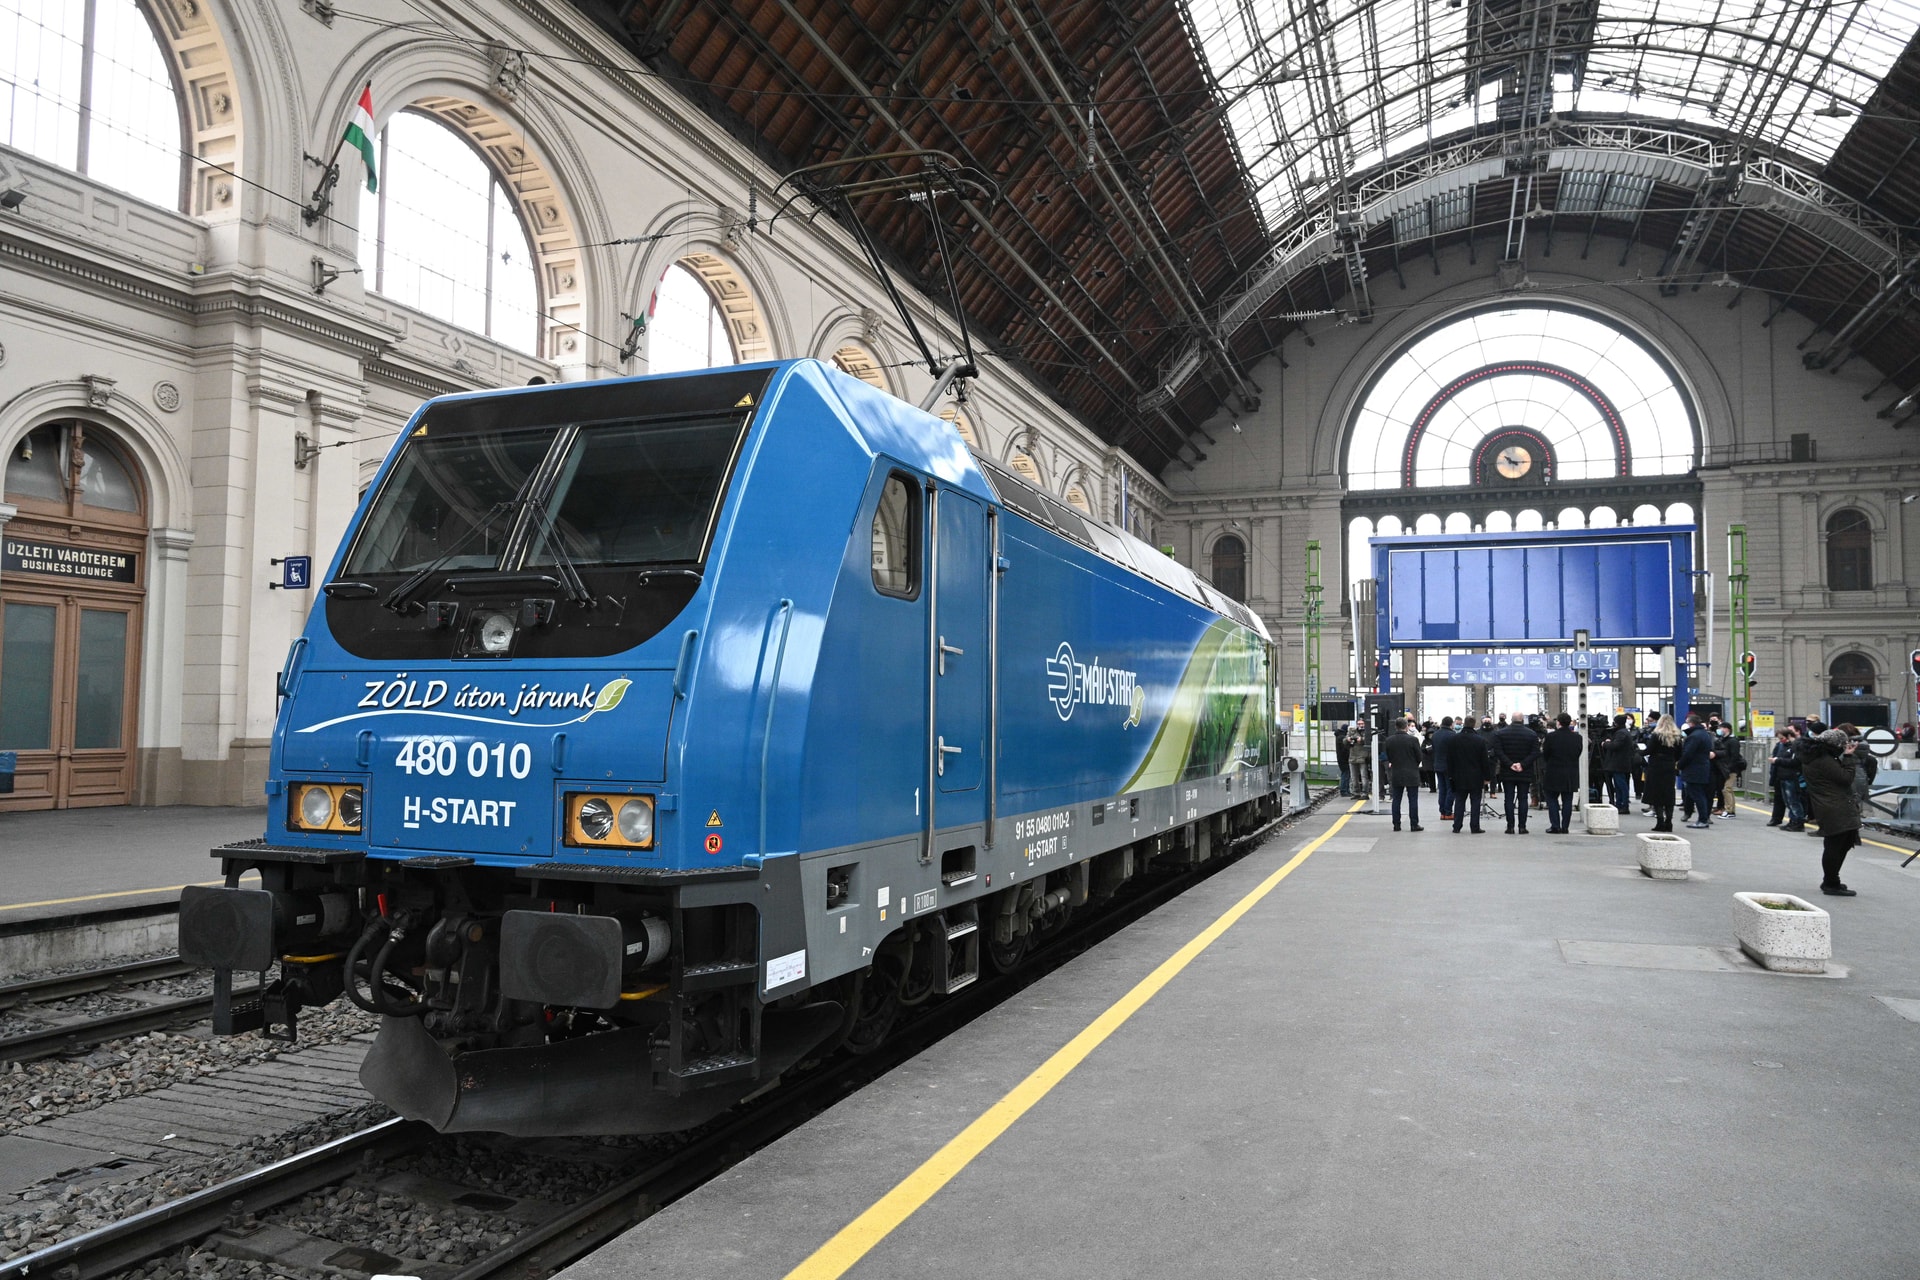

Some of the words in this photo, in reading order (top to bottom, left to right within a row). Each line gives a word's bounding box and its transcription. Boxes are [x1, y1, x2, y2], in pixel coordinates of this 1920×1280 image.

[8, 542, 52, 559] ÜZLETI
[57, 549, 126, 568] VÁRÓTEREM
[22, 560, 72, 573] BUSINESS
[75, 566, 113, 578] LOUNGE
[1553, 654, 1561, 665] 8
[1577, 653, 1587, 664] A
[1603, 654, 1612, 664] 7
[358, 673, 449, 709] ZÖLD
[453, 684, 507, 708] úton
[509, 683, 596, 716] járunk
[1082, 656, 1137, 706] MÁV-START
[395, 740, 457, 776] 480
[467, 742, 532, 779] 010
[403, 796, 516, 829] H-START
[914, 787, 920, 816] 1
[1015, 821, 1025, 840] 91
[1026, 818, 1035, 837] 55
[1036, 815, 1052, 835] 0480
[1052, 811, 1070, 831] 010-2
[1028, 837, 1058, 867] H-START
[921, 894, 930, 908] 100
